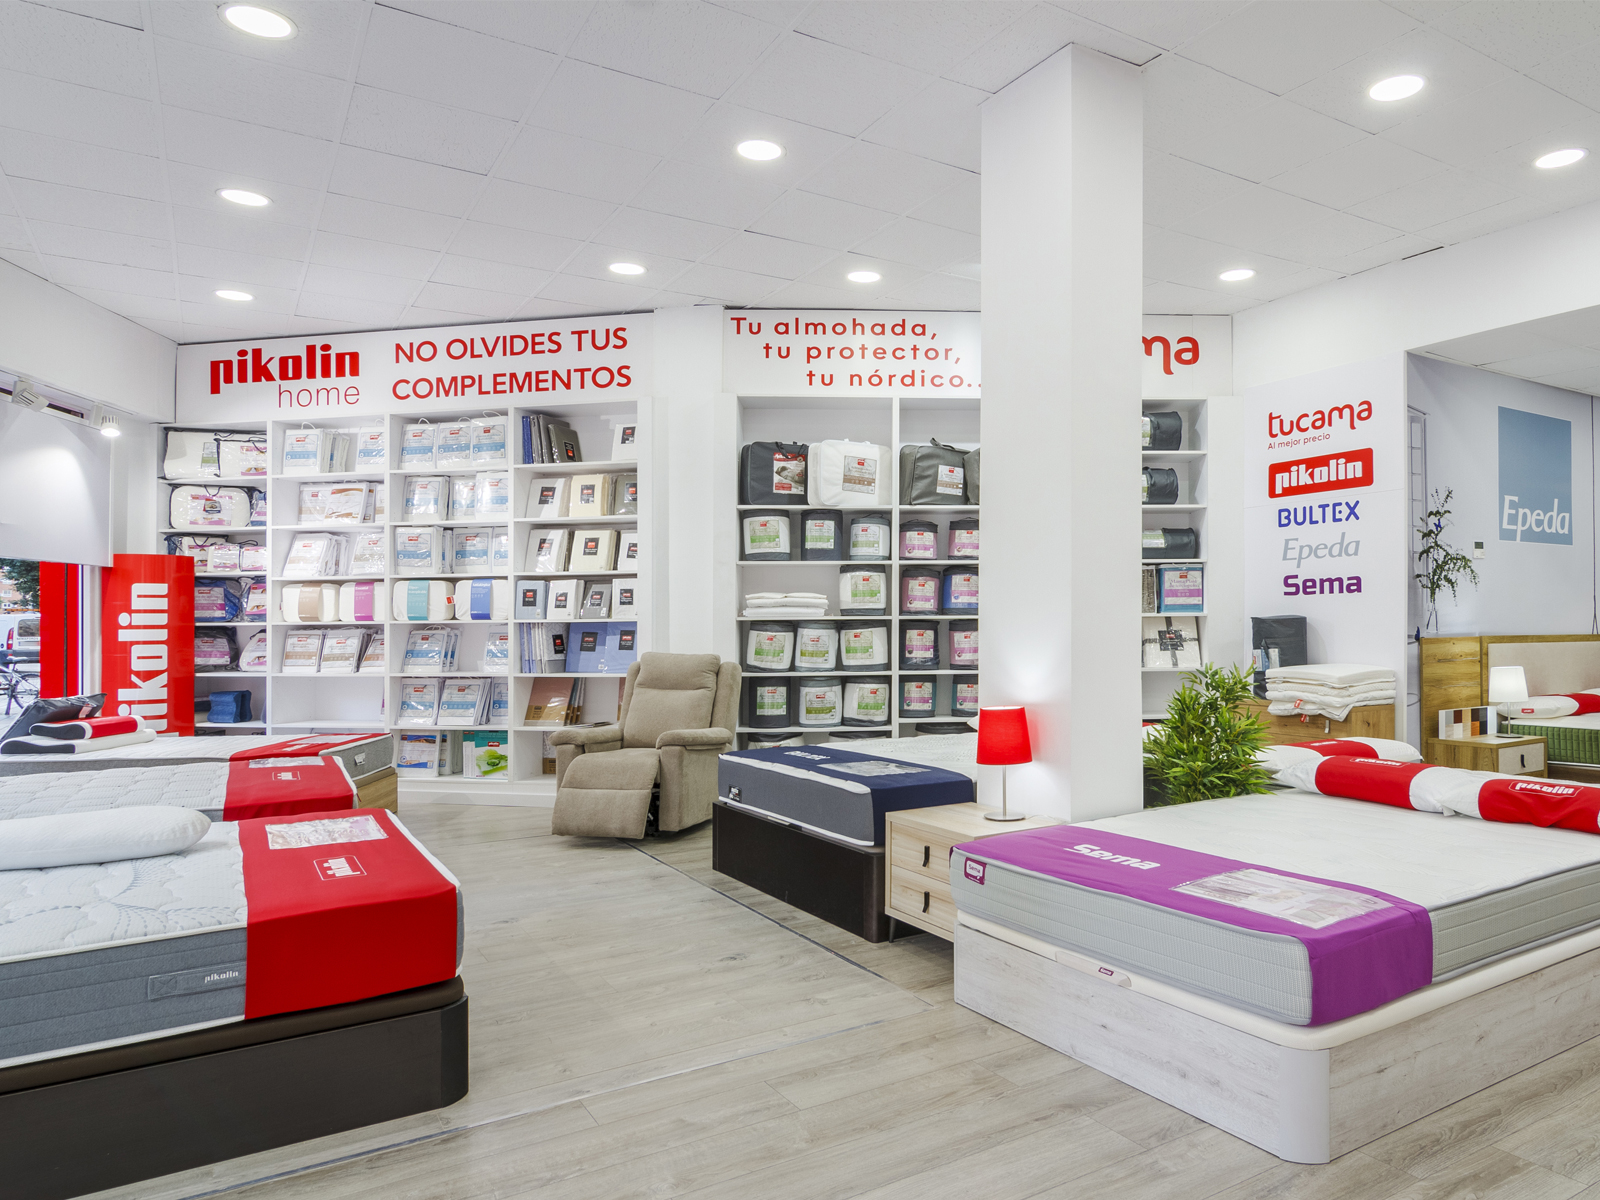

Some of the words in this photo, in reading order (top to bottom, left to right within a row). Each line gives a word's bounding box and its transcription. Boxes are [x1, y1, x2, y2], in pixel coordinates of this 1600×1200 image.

[731, 318, 762, 335] Tu
[774, 317, 937, 340] almohada,
[395, 340, 438, 364] NO
[446, 331, 562, 361] OLVIDES
[571, 327, 628, 353] TUS
[763, 343, 791, 359] tu
[806, 344, 961, 365] protector,
[210, 343, 360, 395] pikolin
[806, 370, 834, 387] tu
[392, 364, 632, 400] COMPLEMENTOS
[278, 383, 360, 408] home
[1268, 400, 1373, 438] tucama
[1267, 442, 1276, 450] Al
[1277, 437, 1302, 448] mejor
[1303, 432, 1331, 445] precio
[1275, 458, 1363, 494] pikolin
[1277, 500, 1360, 528] BULTEX
[1501, 494, 1570, 542] Epeda
[1281, 531, 1361, 568] Epeda
[1283, 574, 1362, 596] Sema
[1514, 782, 1575, 794] pikolin
[968, 863, 981, 875] Sema
[1063, 844, 1161, 870] Sema
[204, 970, 239, 984] pikolin
